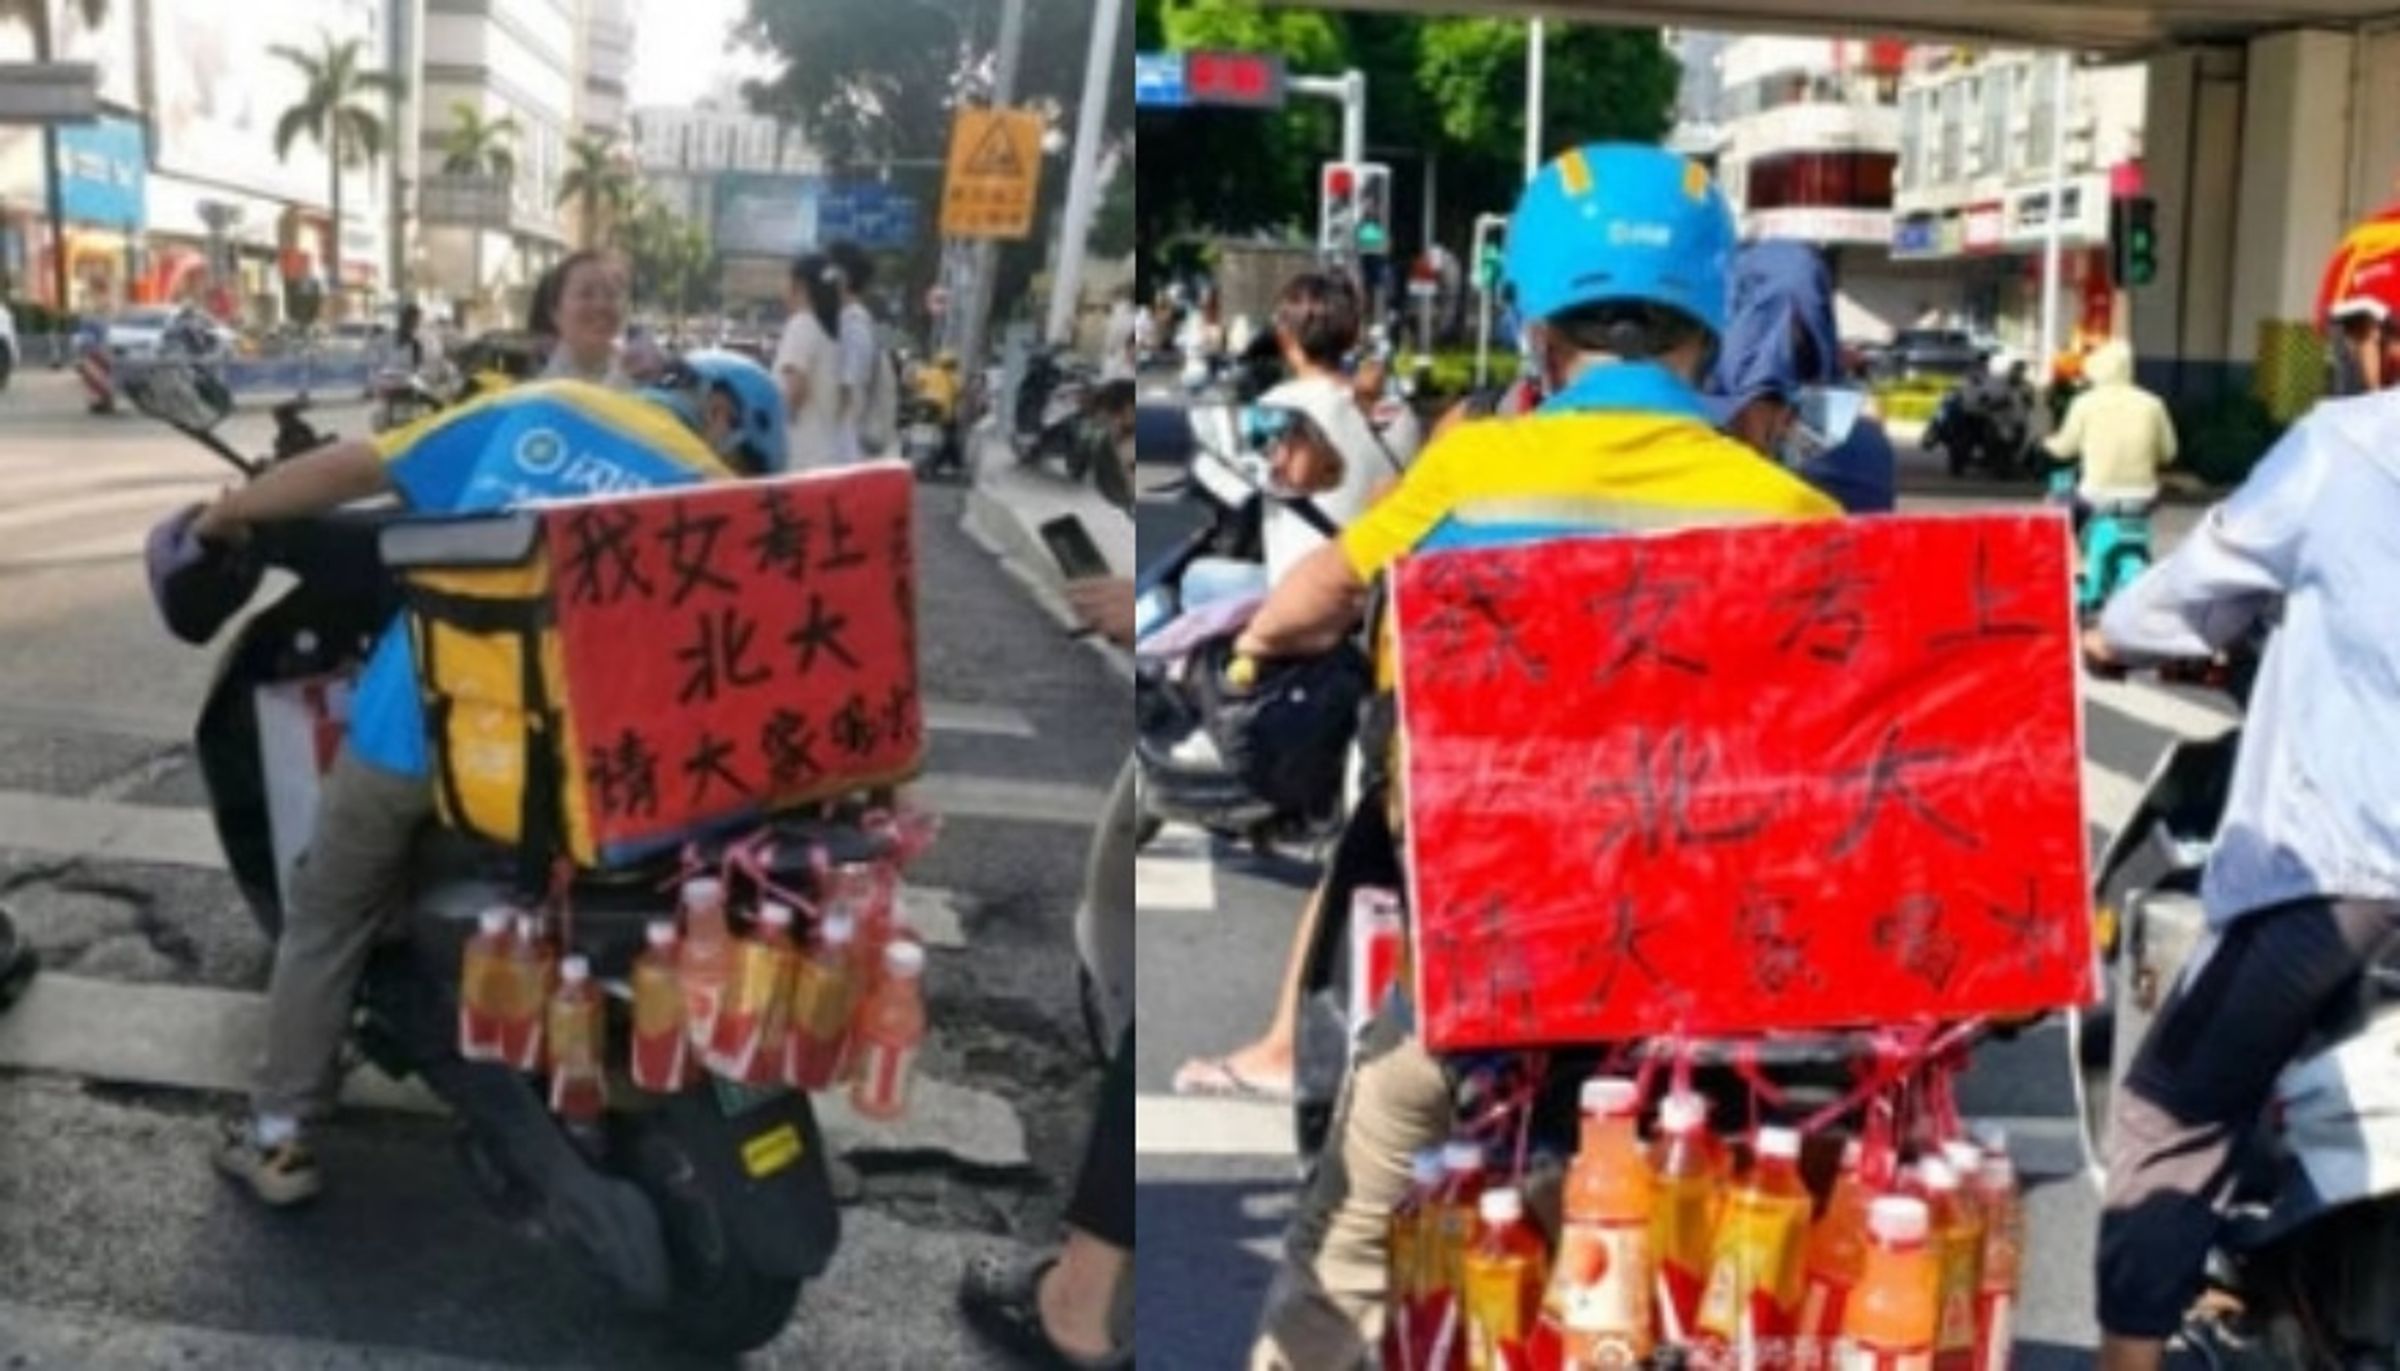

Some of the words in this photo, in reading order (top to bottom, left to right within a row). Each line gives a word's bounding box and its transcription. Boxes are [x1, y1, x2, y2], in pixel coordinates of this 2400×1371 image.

[566, 488, 867, 607] 我女考上
[676, 594, 862, 703] 北大
[1590, 723, 1981, 859] 北大
